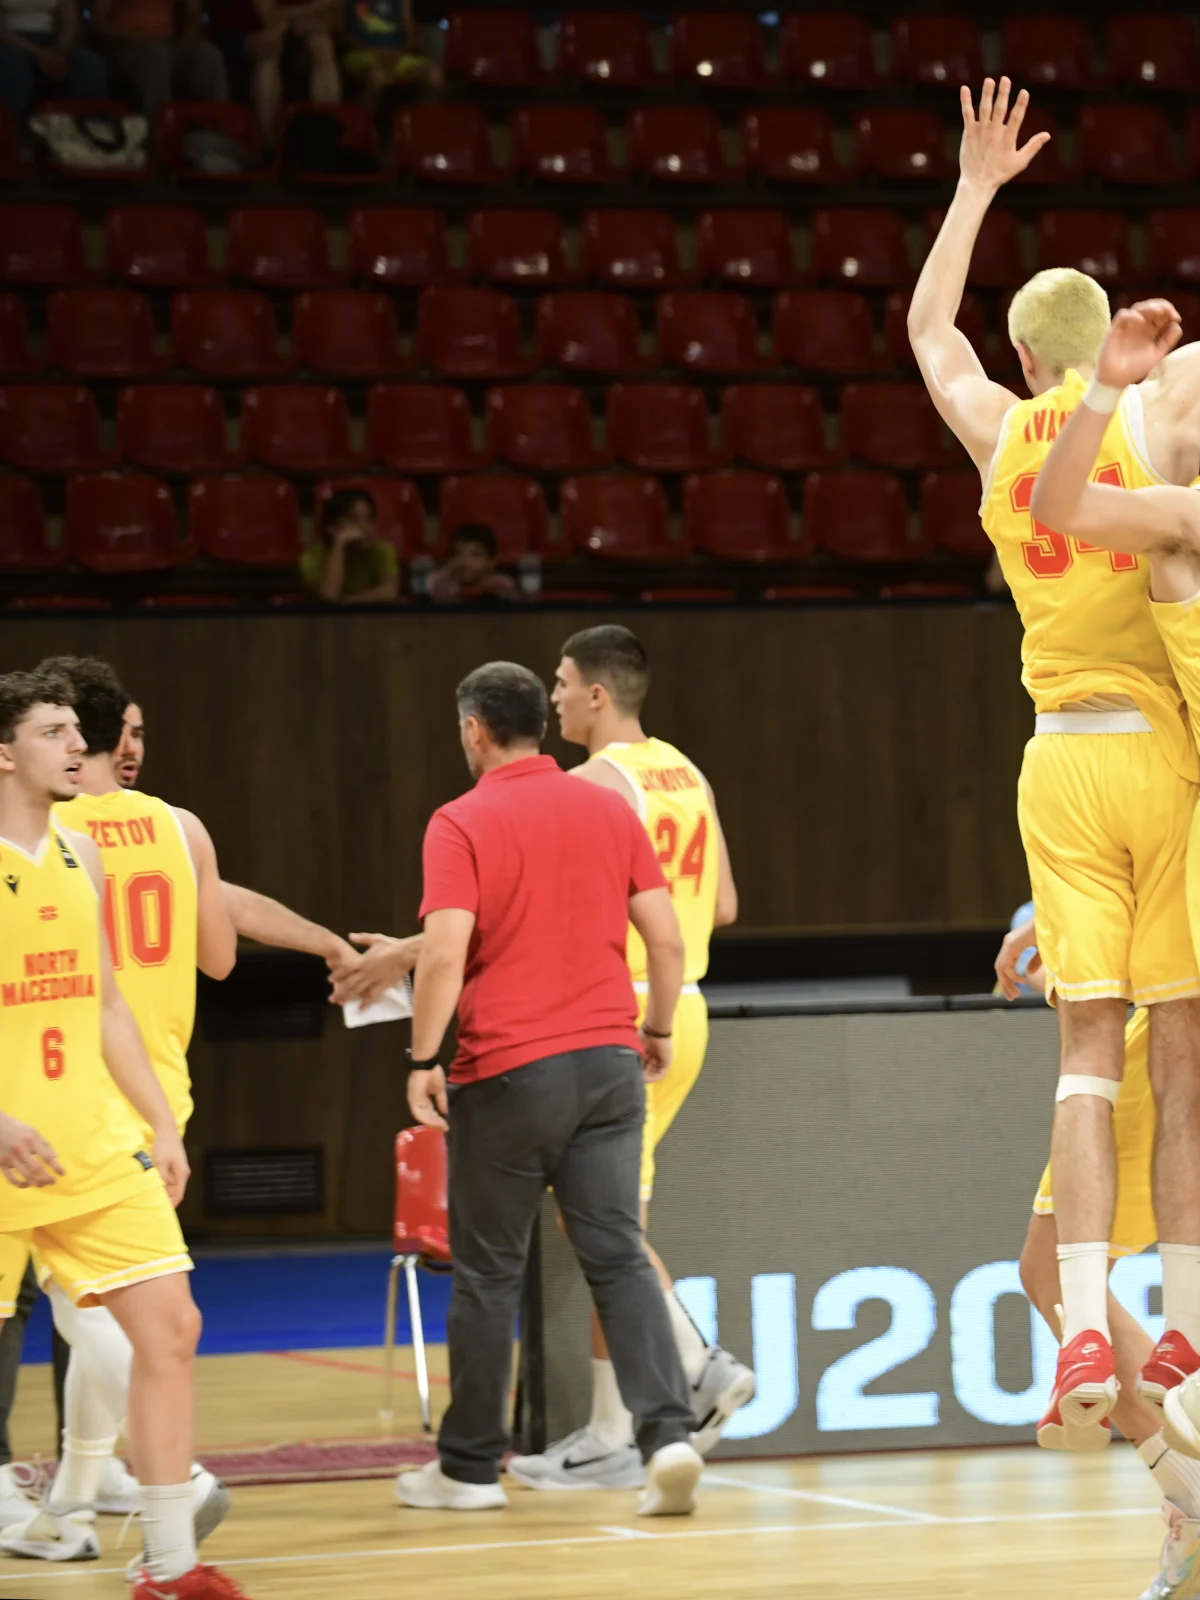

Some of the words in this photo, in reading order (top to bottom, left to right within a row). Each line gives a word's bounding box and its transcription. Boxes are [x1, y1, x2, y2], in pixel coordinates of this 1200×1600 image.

[655, 812, 708, 898] 24
[104, 870, 174, 970] 10
[1, 975, 95, 1007] MACEDONIA
[24, 949, 78, 977] NORTH
[42, 1027, 65, 1080] 6
[674, 1260, 1062, 1440] U20
